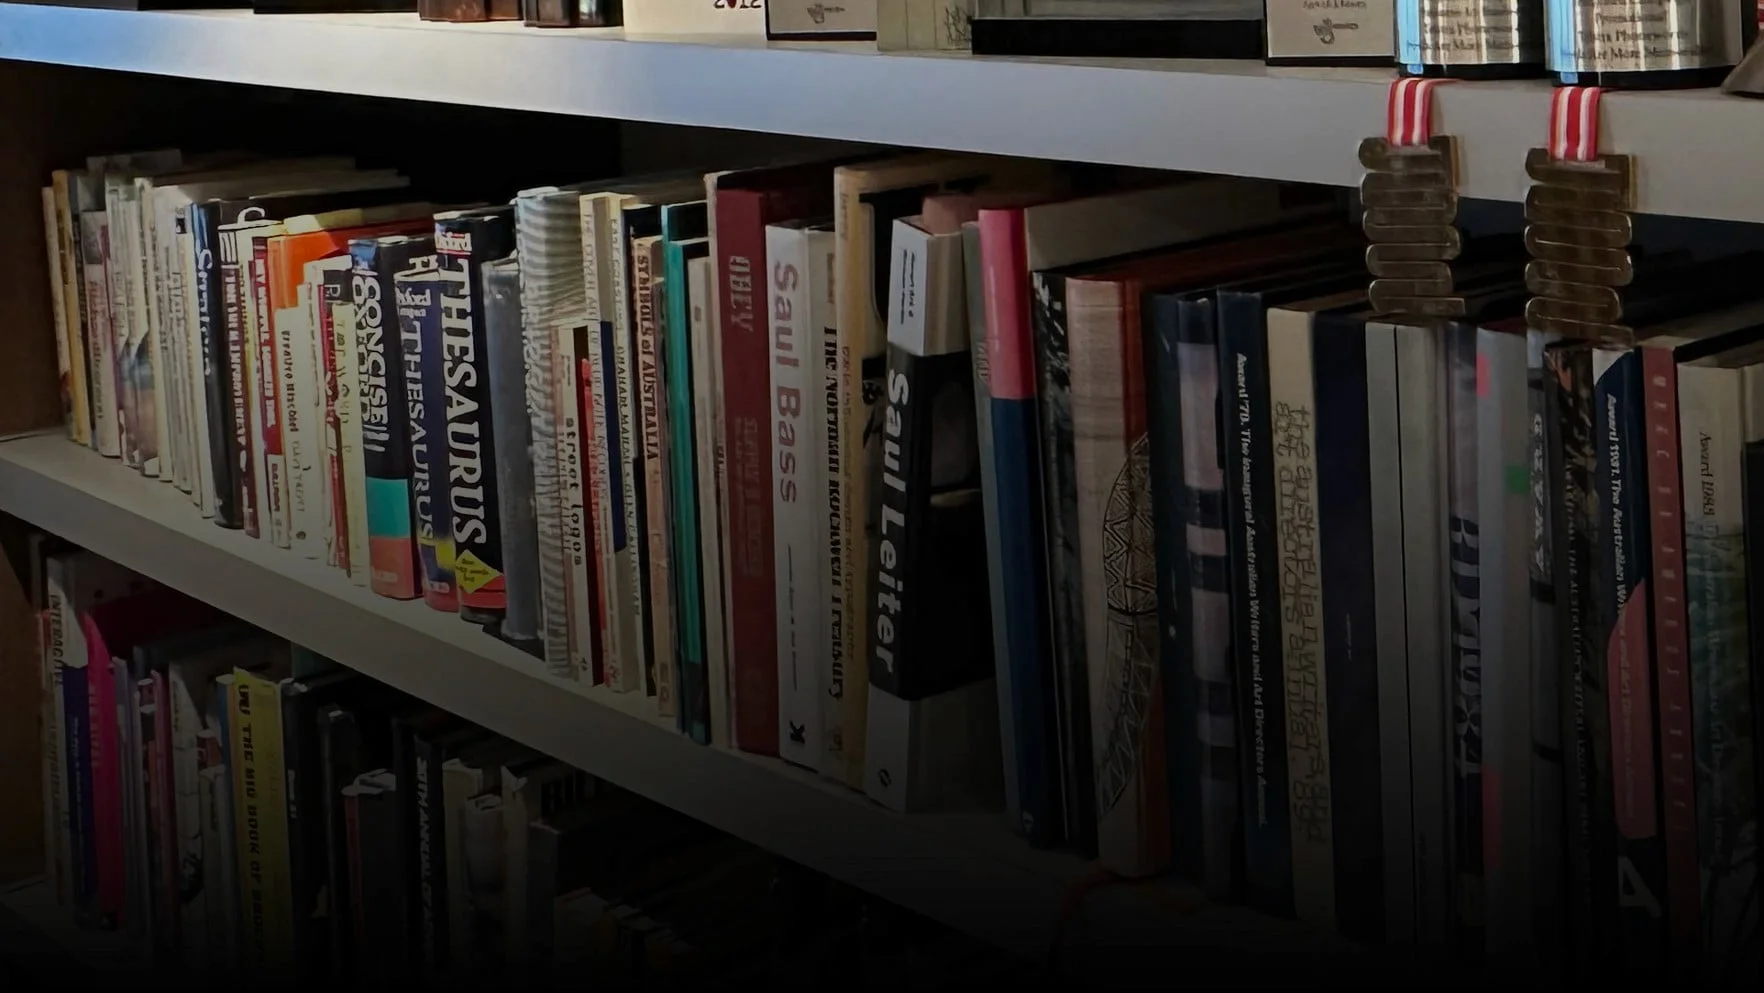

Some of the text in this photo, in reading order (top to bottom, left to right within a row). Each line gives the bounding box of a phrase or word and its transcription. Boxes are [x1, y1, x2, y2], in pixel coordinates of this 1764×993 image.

[366, 277, 388, 425] CONCISE
[637, 256, 653, 337] SYMBOLS
[402, 321, 434, 540] THESAURUS
[439, 258, 488, 544] THESAURUS
[642, 361, 659, 460] AUSTRALIA
[774, 261, 802, 504] Saul Bass
[566, 418, 584, 566] street logos
[875, 369, 911, 675] Saul Leiter
[1611, 507, 1627, 581] Australian
[242, 723, 255, 763] THE
